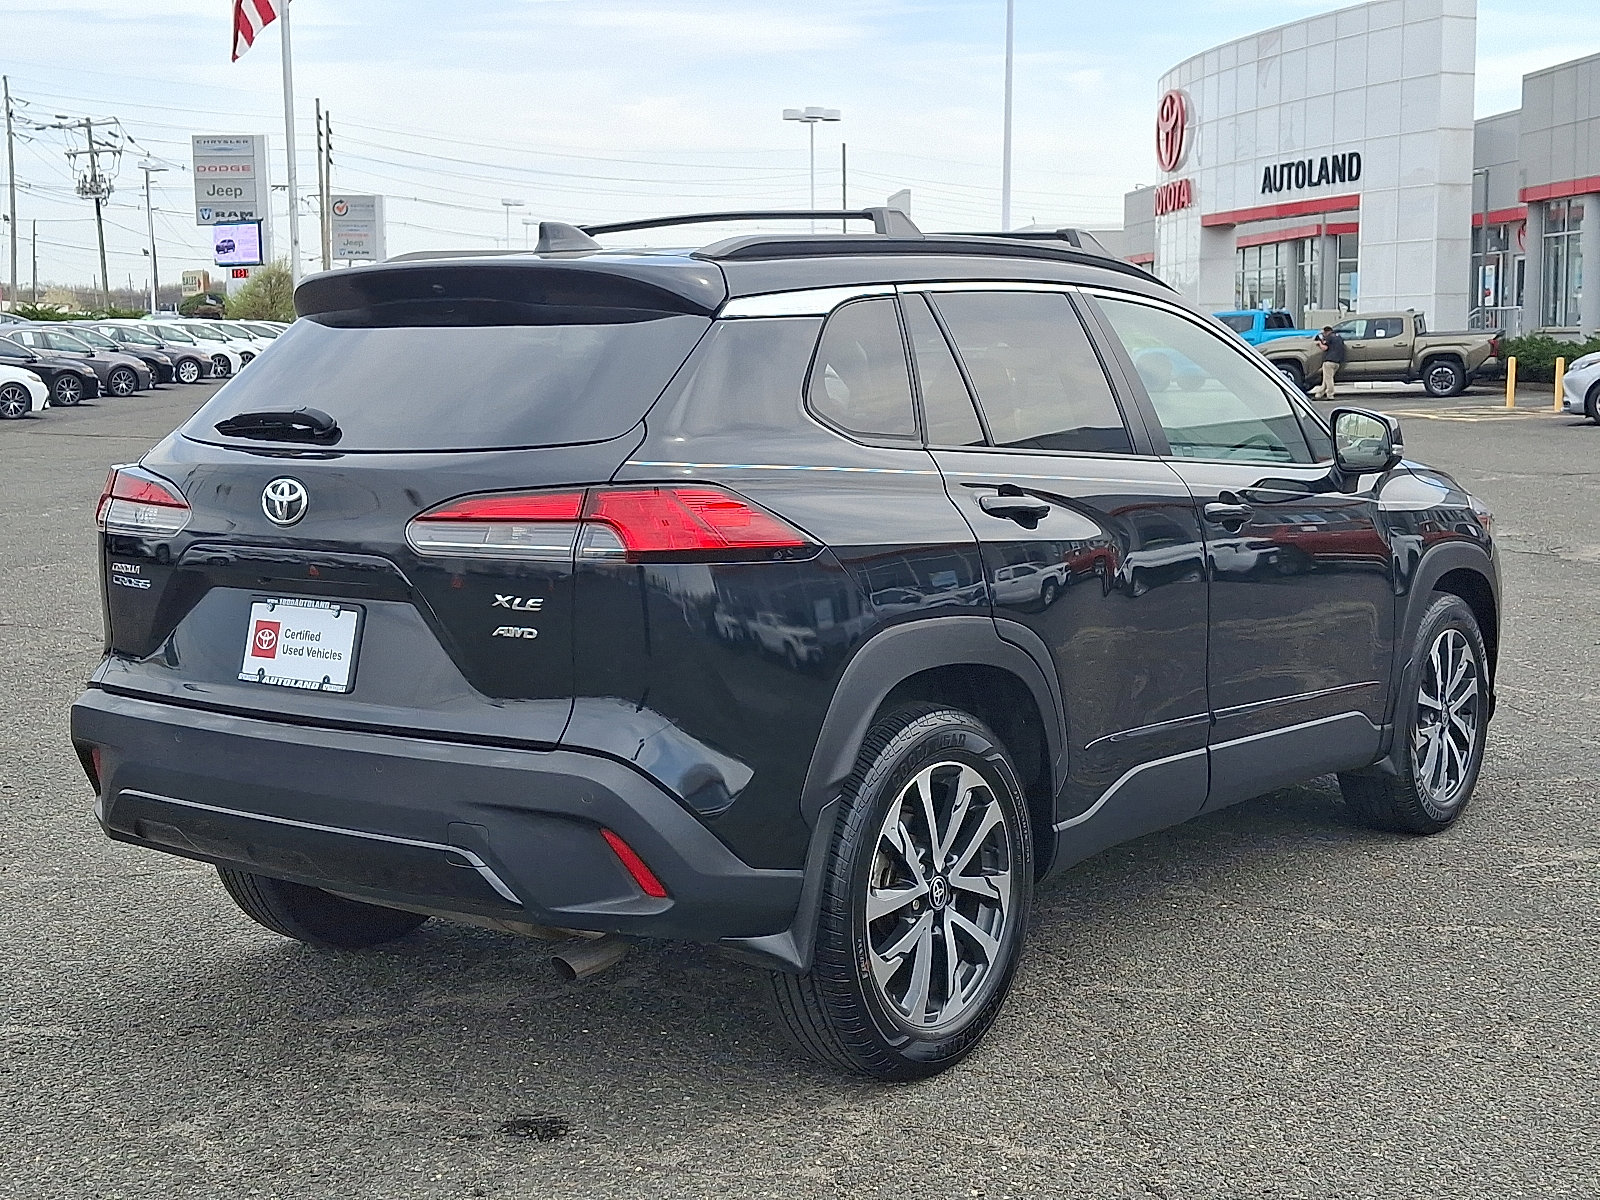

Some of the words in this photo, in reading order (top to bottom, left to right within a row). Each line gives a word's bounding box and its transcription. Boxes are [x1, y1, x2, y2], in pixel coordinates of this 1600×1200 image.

[196, 164, 251, 172] DODGE
[1261, 152, 1362, 194] AUTOLAND
[206, 183, 243, 198] Jeep
[215, 210, 254, 218] RAM
[112, 574, 152, 590] CROSS
[491, 593, 544, 611] XLE
[284, 628, 321, 642] Certified
[491, 626, 538, 639] AWD
[281, 643, 304, 657] Used
[306, 646, 343, 661] Vehicles
[262, 675, 321, 690] AUTOLAND
